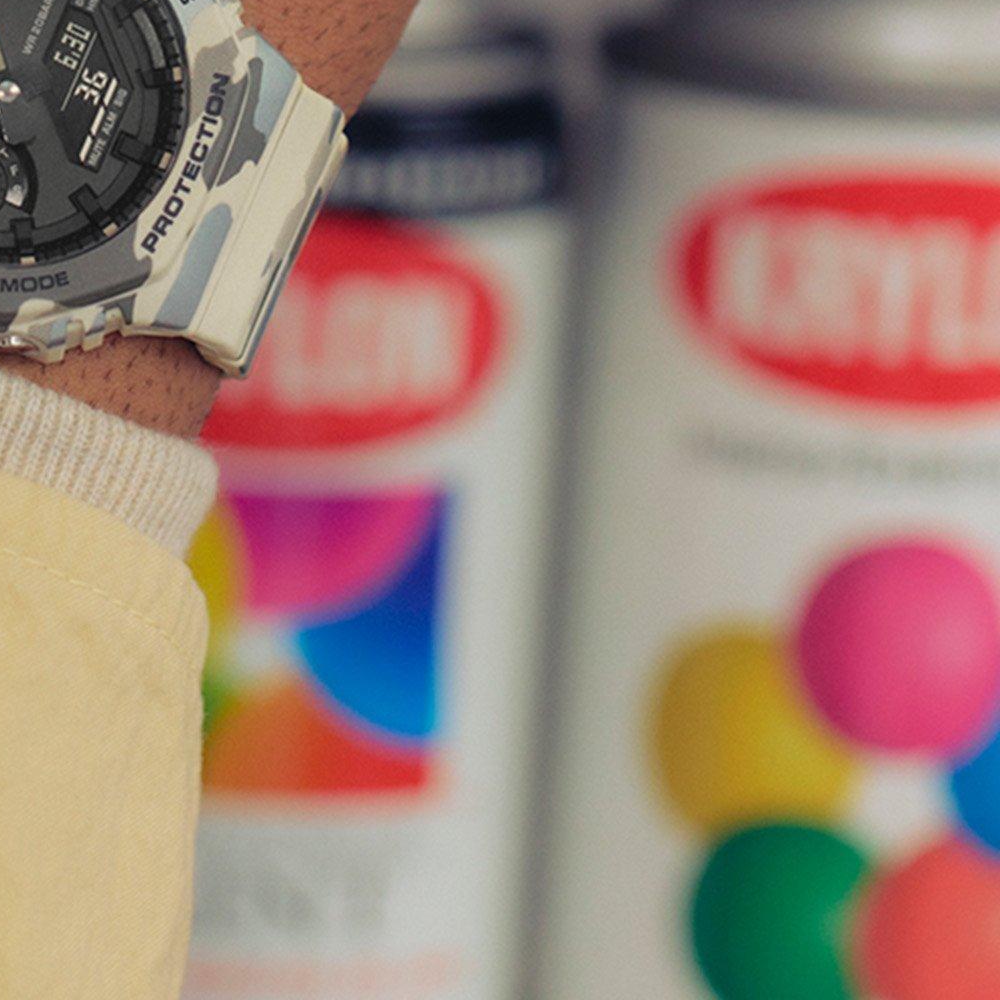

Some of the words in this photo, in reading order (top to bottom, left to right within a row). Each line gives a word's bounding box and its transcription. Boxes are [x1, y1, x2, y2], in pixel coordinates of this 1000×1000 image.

[73, 67, 109, 107] 36
[141, 73, 231, 255] PROTECTION
[0, 271, 70, 294] MODE
